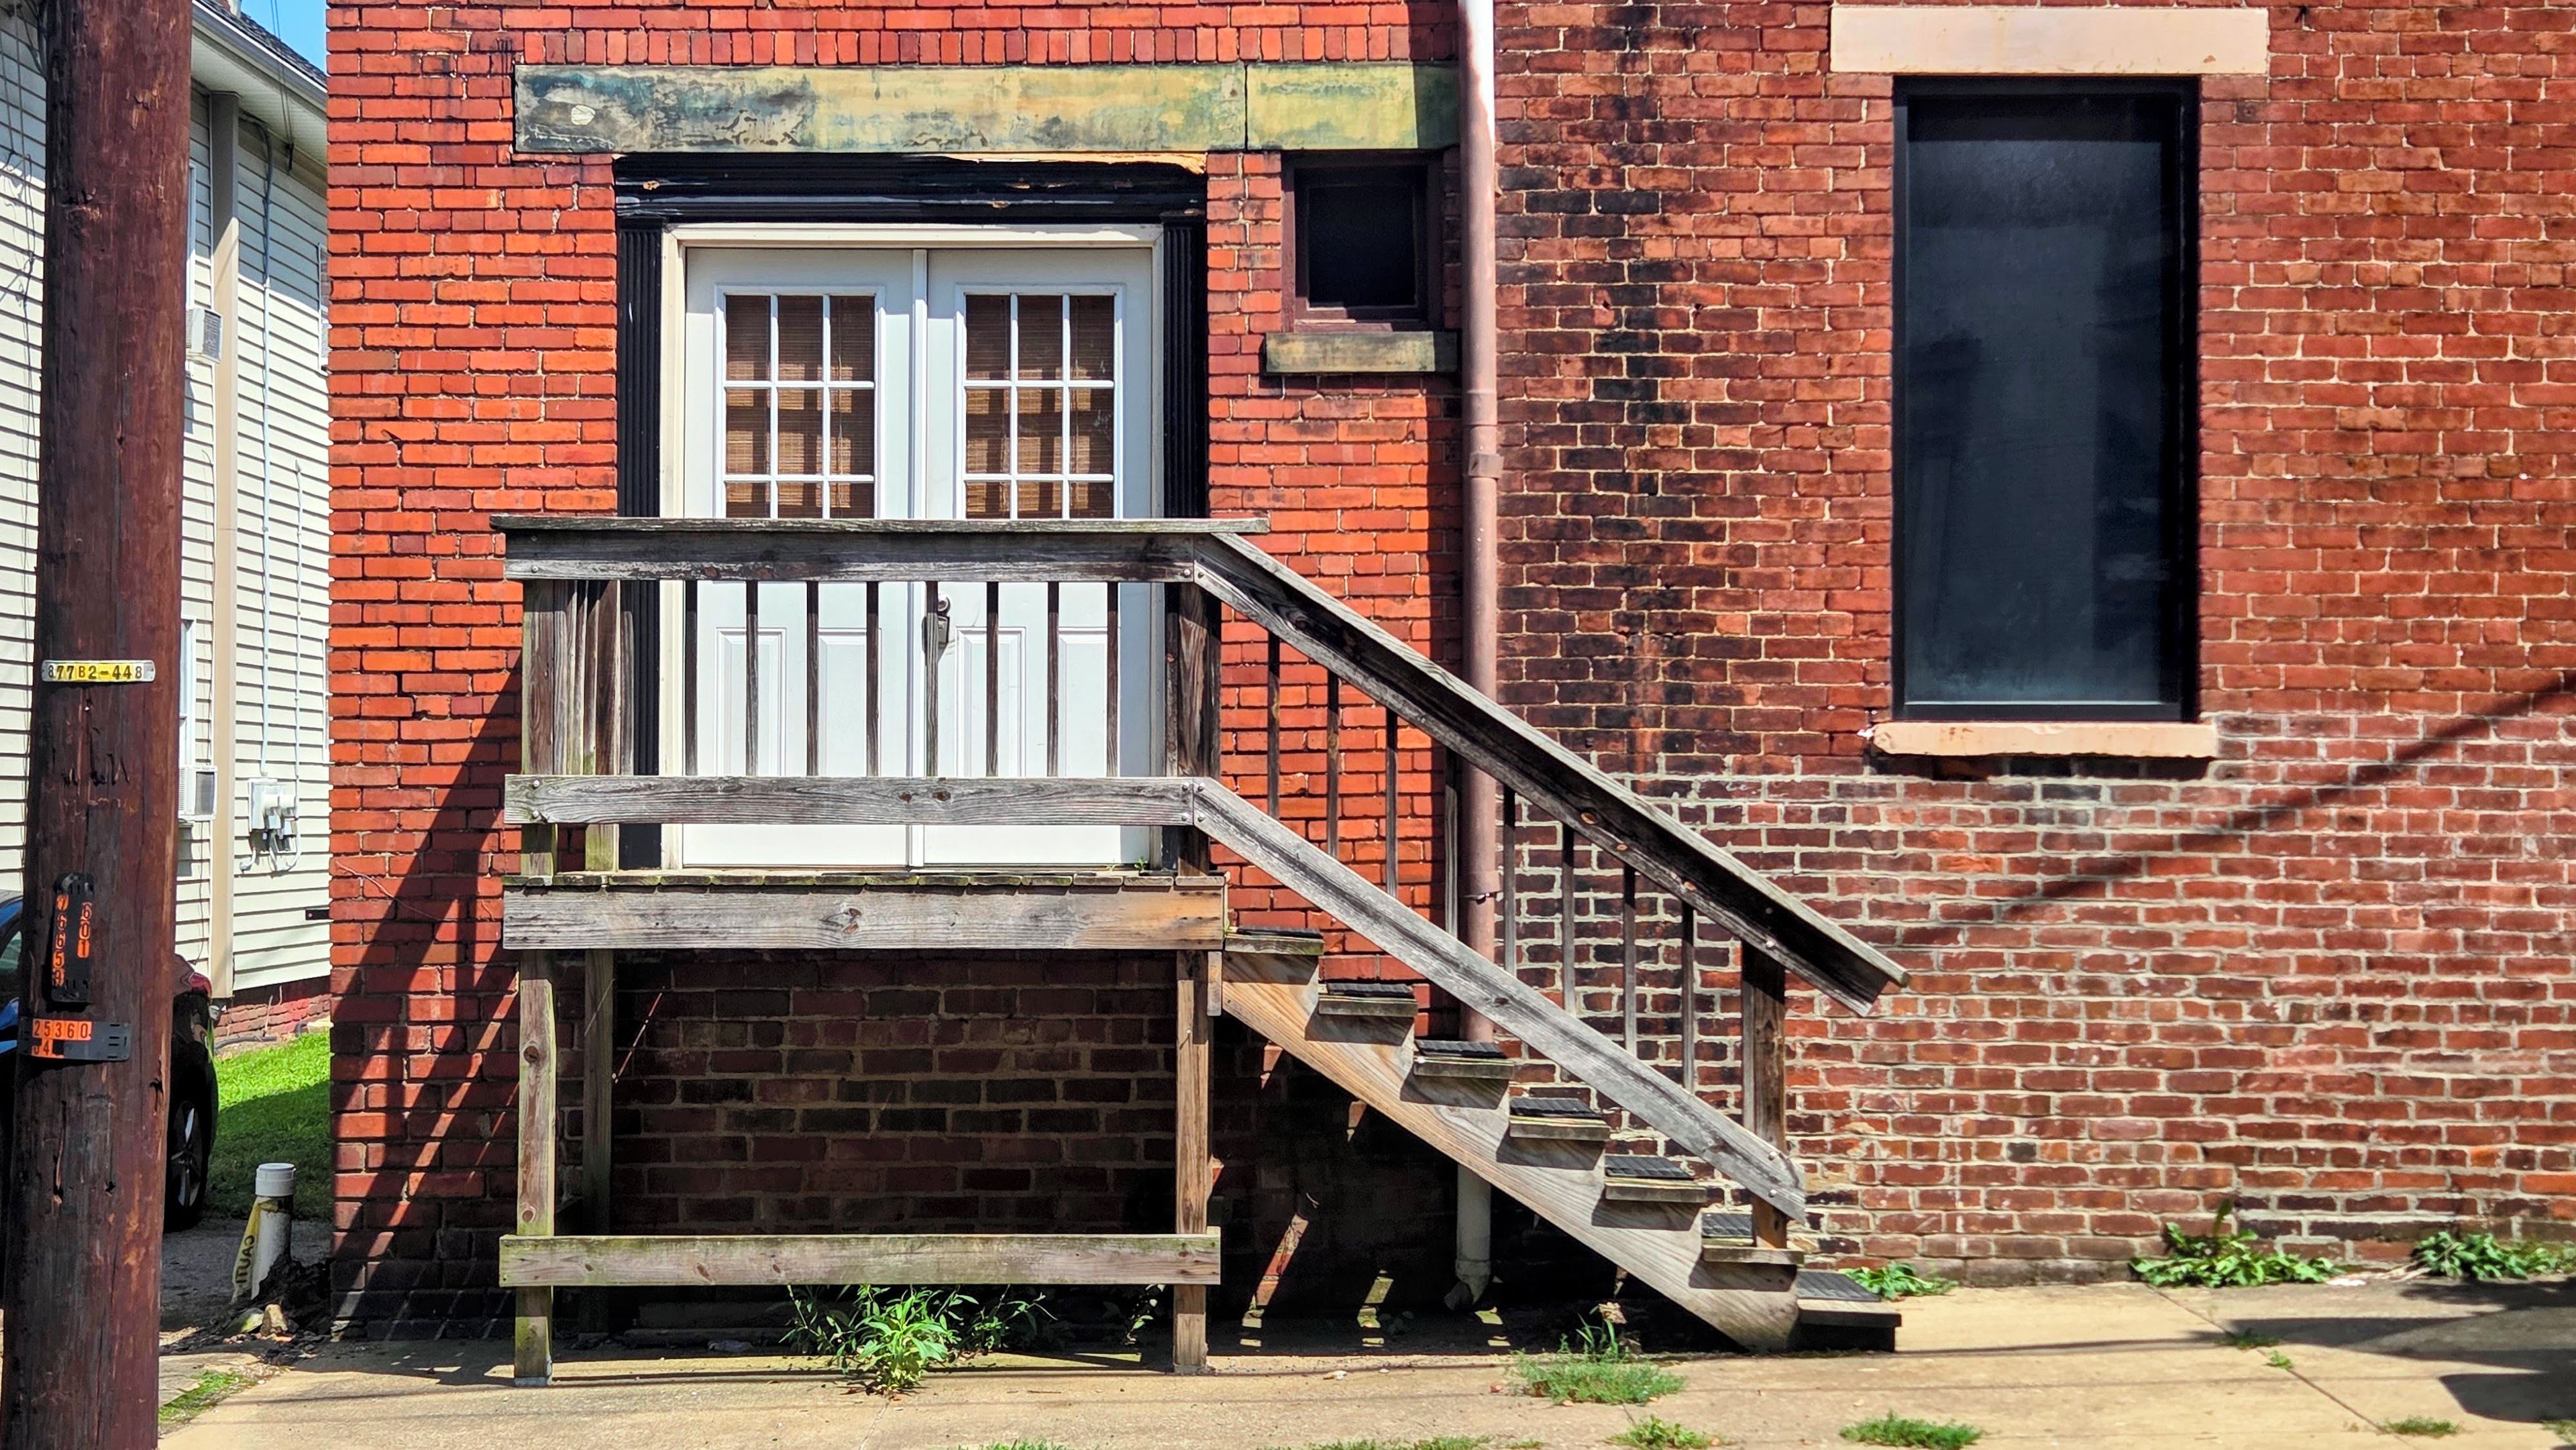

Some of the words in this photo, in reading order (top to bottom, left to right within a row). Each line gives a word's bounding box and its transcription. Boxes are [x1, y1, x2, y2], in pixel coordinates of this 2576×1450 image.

[48, 665, 142, 680] 877B2-448
[77, 903, 93, 958] 601
[34, 1020, 89, 1039] 25360
